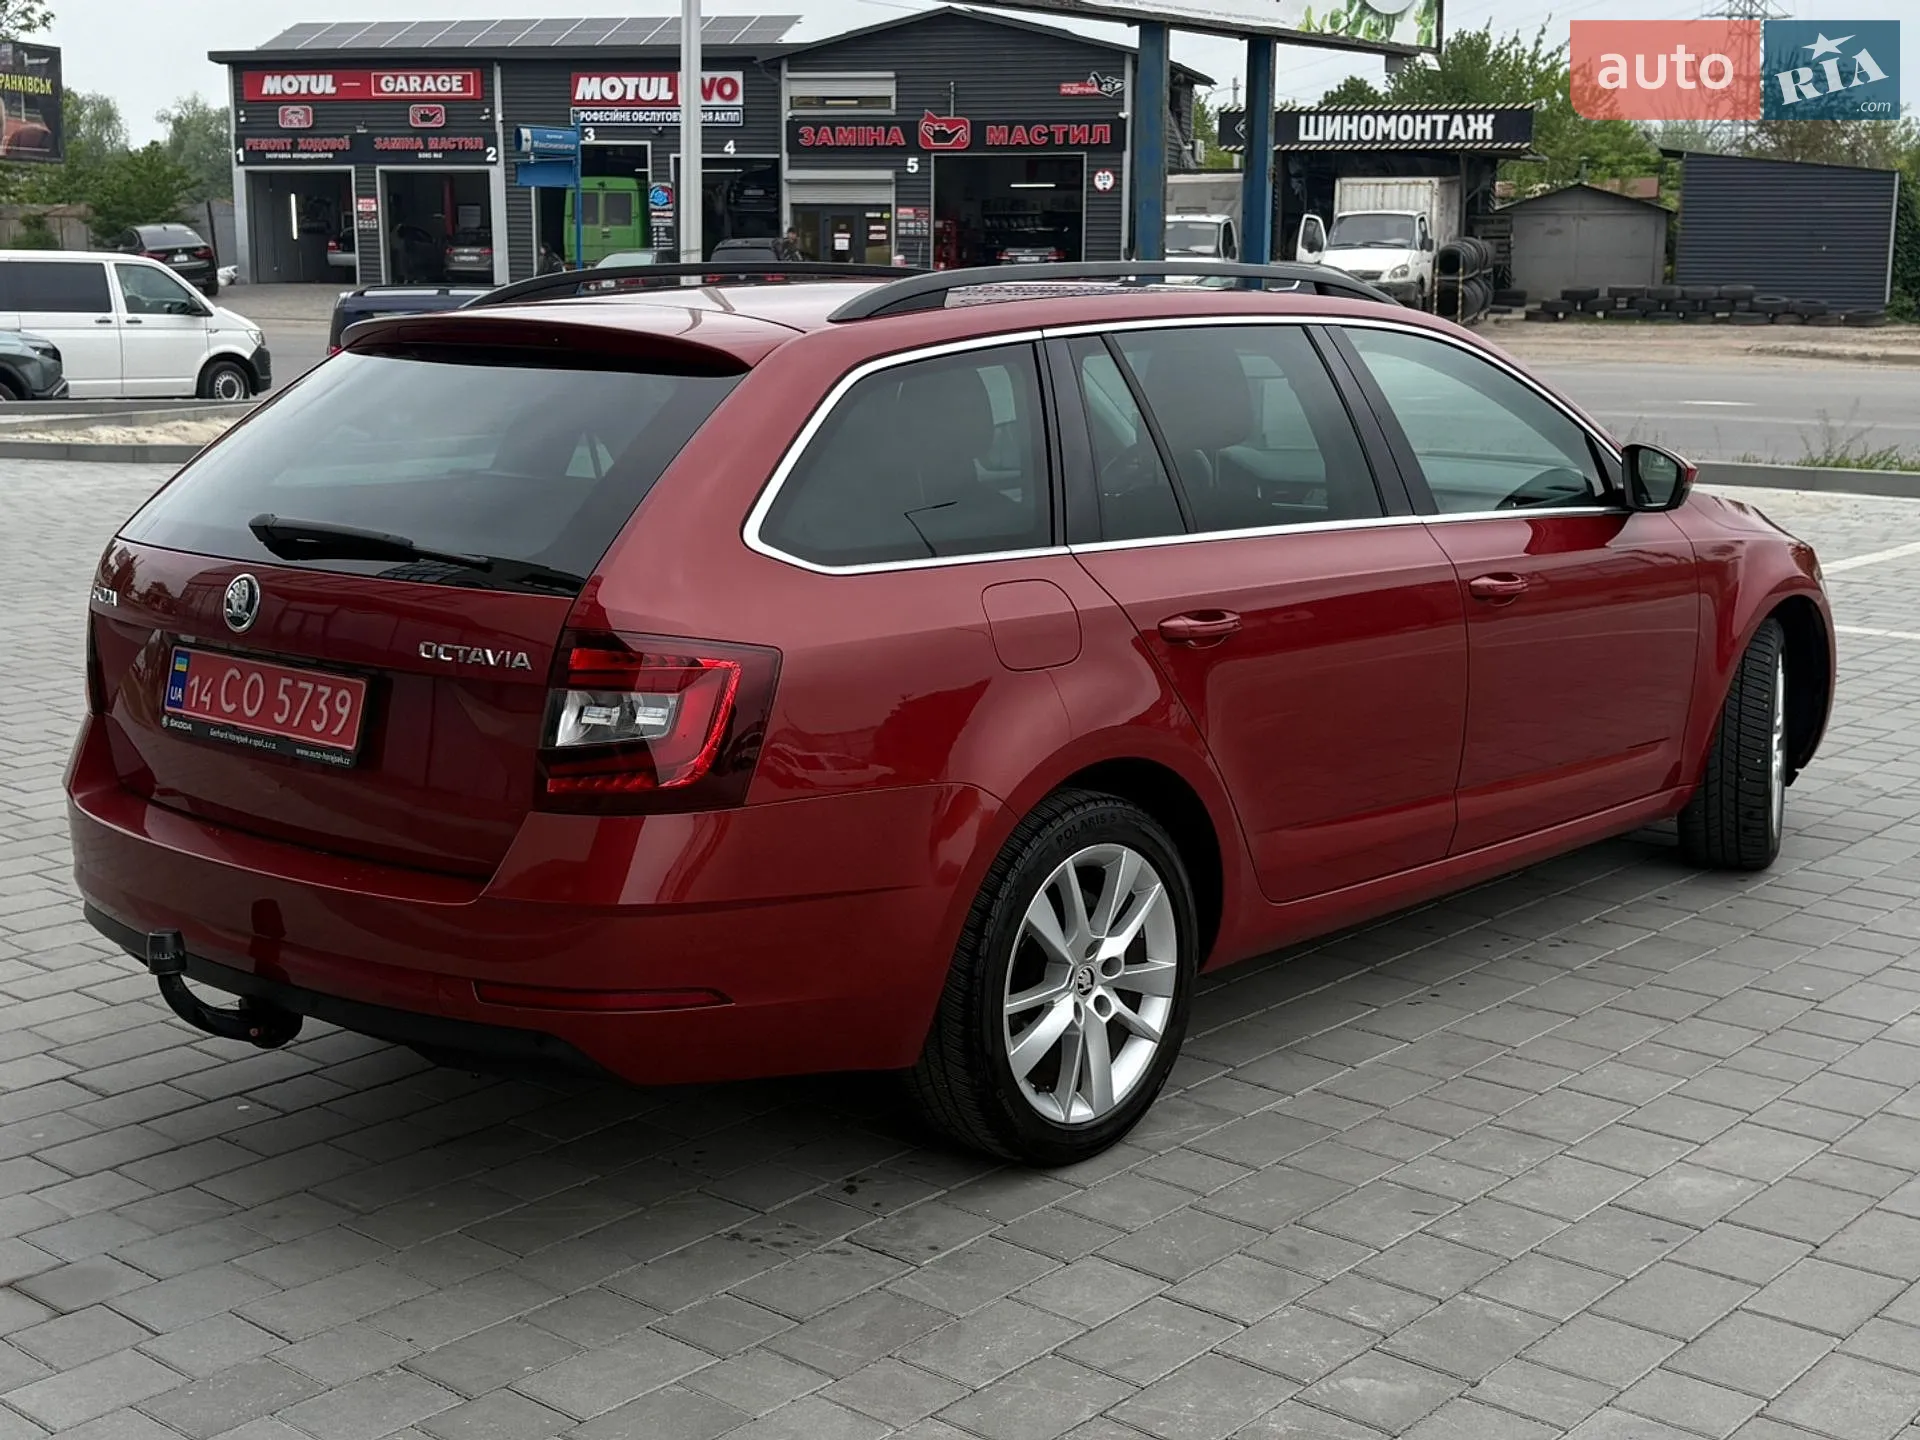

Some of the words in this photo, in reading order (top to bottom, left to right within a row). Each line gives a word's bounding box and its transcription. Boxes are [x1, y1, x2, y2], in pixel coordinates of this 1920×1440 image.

[0, 73, 52, 94] РАНКІВСЬК
[261, 74, 337, 95] MOTUL
[380, 75, 464, 93] GARAGE
[574, 76, 674, 101] MOTUL
[701, 77, 739, 102] VO
[577, 109, 631, 122] РОФЕСІЙНЕ
[714, 111, 740, 122] АКПП
[584, 128, 596, 142] 3
[798, 125, 907, 147] ЗАМІНА
[986, 124, 1111, 146] МАСТИЛ
[1298, 114, 1496, 141] ШИНОМОНТАЖ
[236, 147, 245, 162] 1
[486, 146, 497, 162] 2
[724, 140, 736, 155] 4
[906, 157, 919, 174] 5
[419, 641, 532, 671] OCTAVIA
[170, 686, 183, 702] UA
[273, 678, 352, 736] 5739
[1056, 812, 1106, 848] POLARIS
